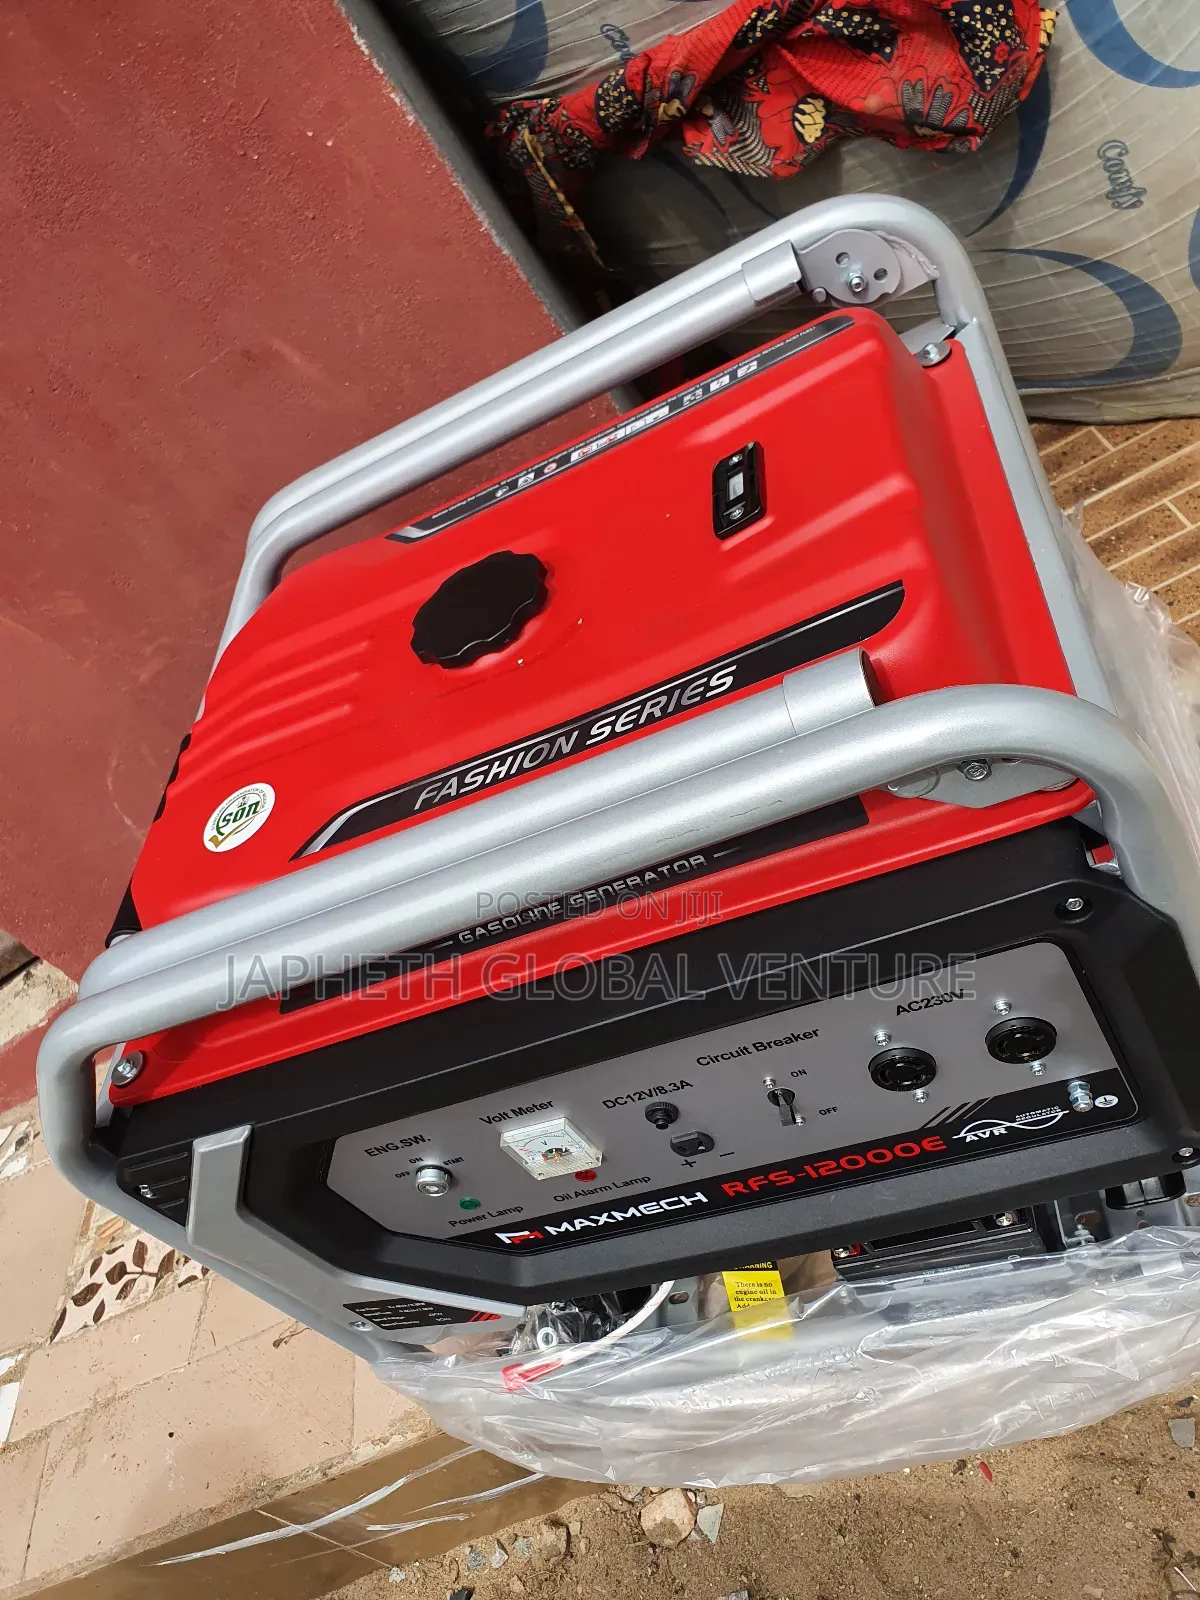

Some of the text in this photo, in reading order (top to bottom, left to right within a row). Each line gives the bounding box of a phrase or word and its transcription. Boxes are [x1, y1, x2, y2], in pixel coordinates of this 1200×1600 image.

[413, 664, 737, 810] FASHION SERIES
[458, 853, 708, 945] GASOLINE GENERATOR
[896, 988, 964, 1016] AC230V
[696, 1027, 820, 1066] Circuit Breaker
[790, 1068, 808, 1078] ON
[602, 1079, 694, 1109] DC12V/8.3A
[479, 1101, 555, 1126] Volt Meter
[818, 1106, 838, 1116] OFF
[1015, 1105, 1060, 1119] AUTOMATIC
[1015, 1109, 1062, 1122] REGULATOR
[364, 1134, 431, 1157] ENG.SW.
[966, 1127, 1008, 1143] AVR
[408, 1157, 424, 1165] ON
[442, 1156, 465, 1166] START
[721, 1135, 947, 1197] RFS-12000E
[394, 1171, 411, 1179] OFF
[553, 1174, 652, 1203] Oil Alarm Lamp
[448, 1205, 524, 1228] Power Lamp
[544, 1191, 709, 1236] MAXMECH
